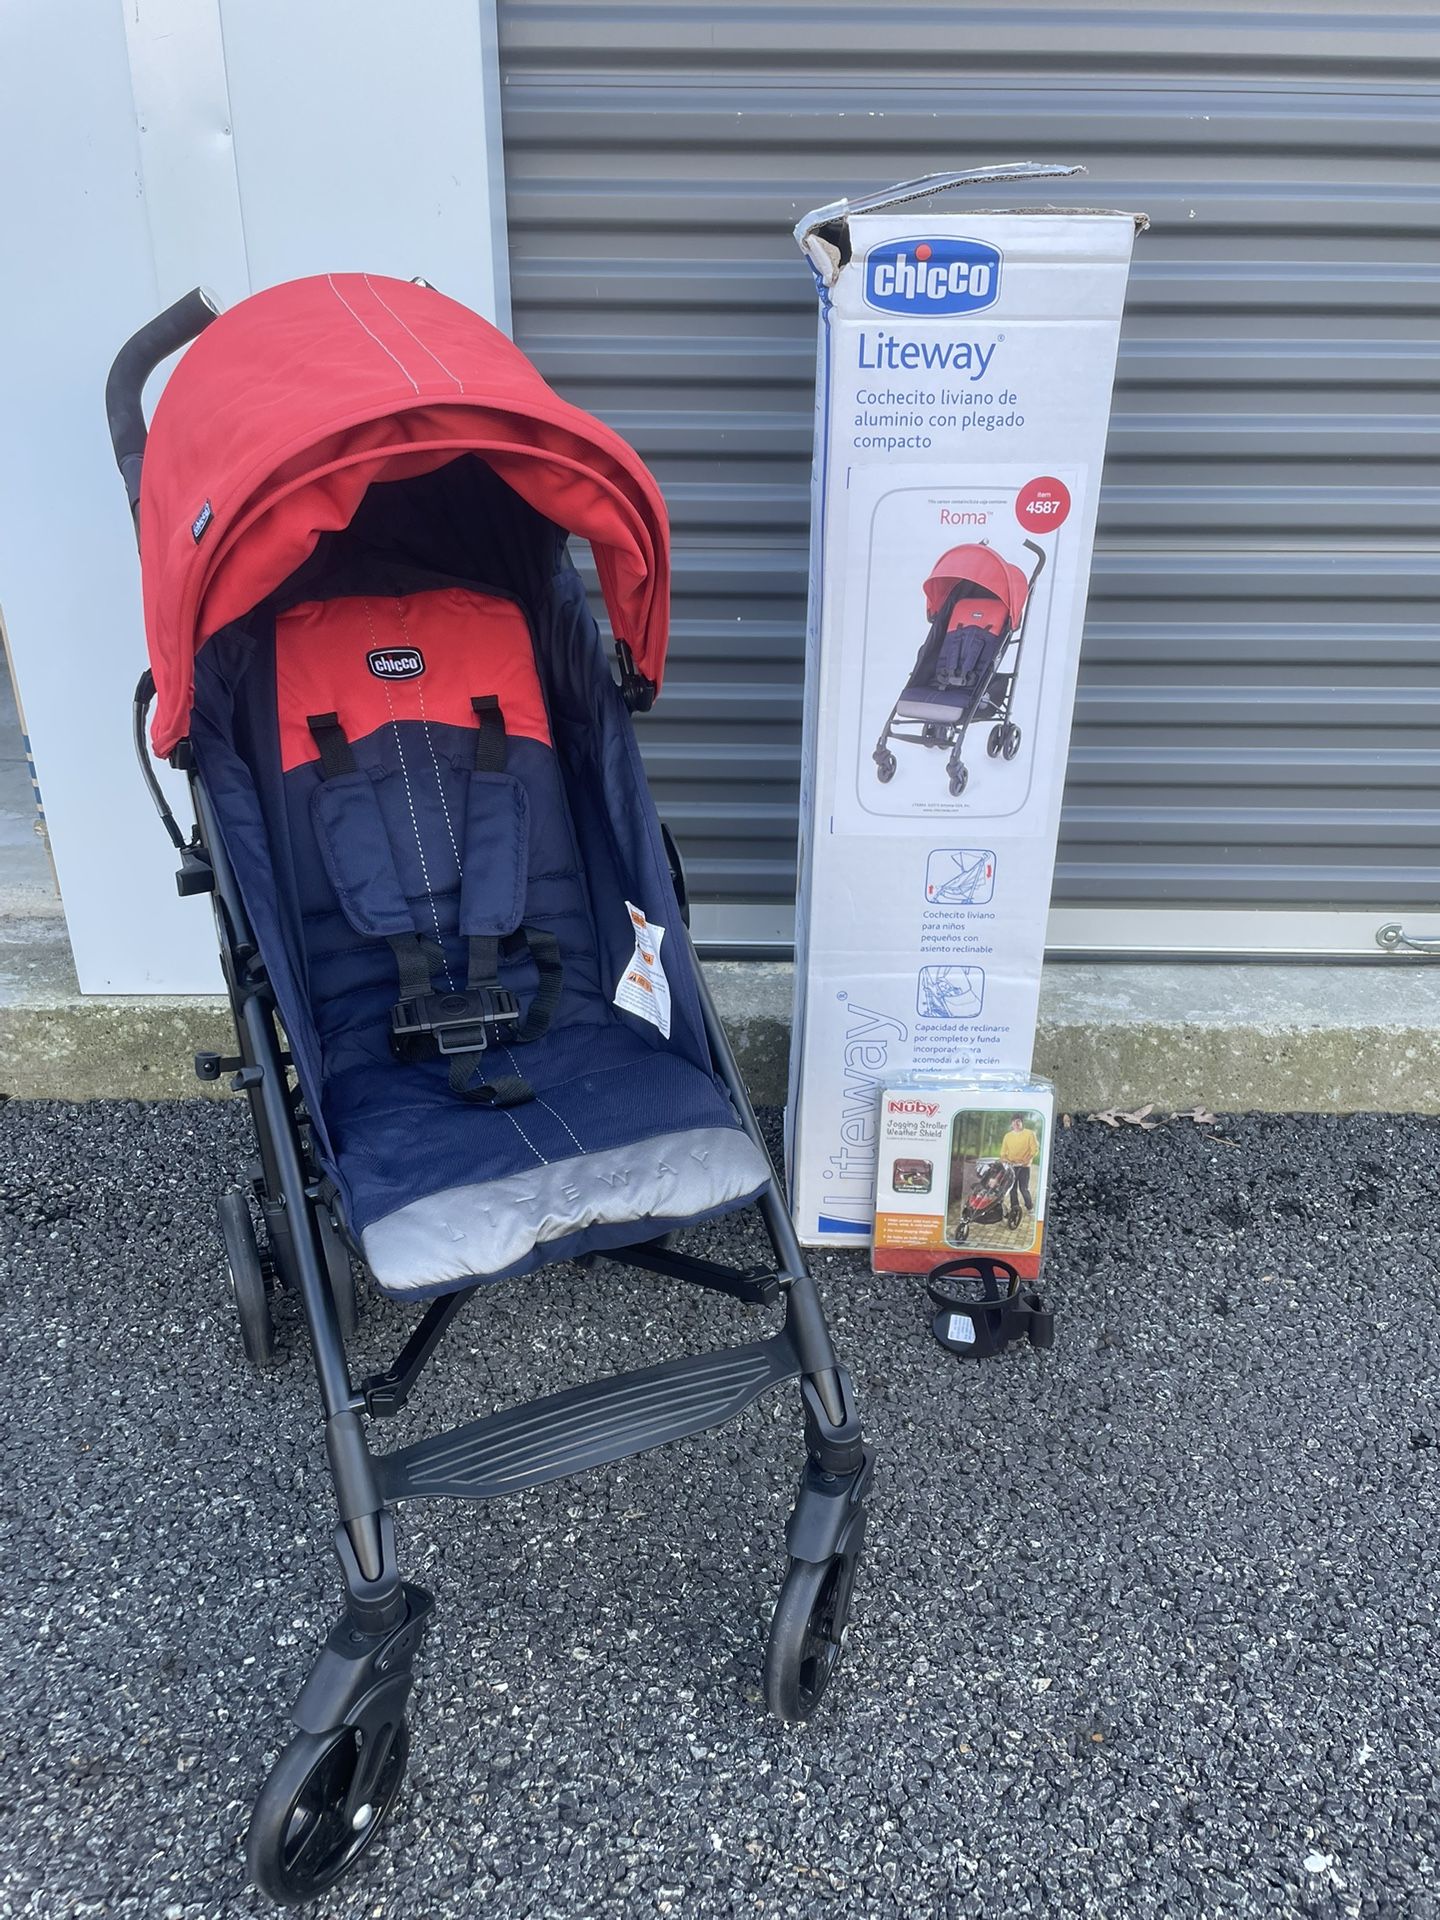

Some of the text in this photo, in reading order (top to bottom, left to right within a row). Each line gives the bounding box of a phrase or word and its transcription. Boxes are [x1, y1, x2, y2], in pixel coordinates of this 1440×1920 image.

[874, 244, 990, 300] chicco
[856, 389, 1017, 405] Cochecito liviano de
[854, 411, 1025, 431] aluminio con plegado
[853, 435, 932, 452] compacto
[1025, 501, 1060, 514] 4587
[374, 654, 418, 672] chicco
[923, 911, 996, 919] Cochecito liviano
[922, 922, 966, 931] para niños
[920, 934, 962, 943] pequeños
[920, 945, 993, 954] asiento reclinable
[914, 1023, 1010, 1033] Capacidad de reclinarse
[929, 1035, 969, 1043] completo
[970, 1036, 976, 1044] y
[977, 1035, 1001, 1043] funda
[913, 1046, 958, 1054] incorporad
[975, 1057, 1000, 1065] recién
[886, 1119, 948, 1130] Jogging Stroller
[886, 1127, 942, 1138] Weather Shield
